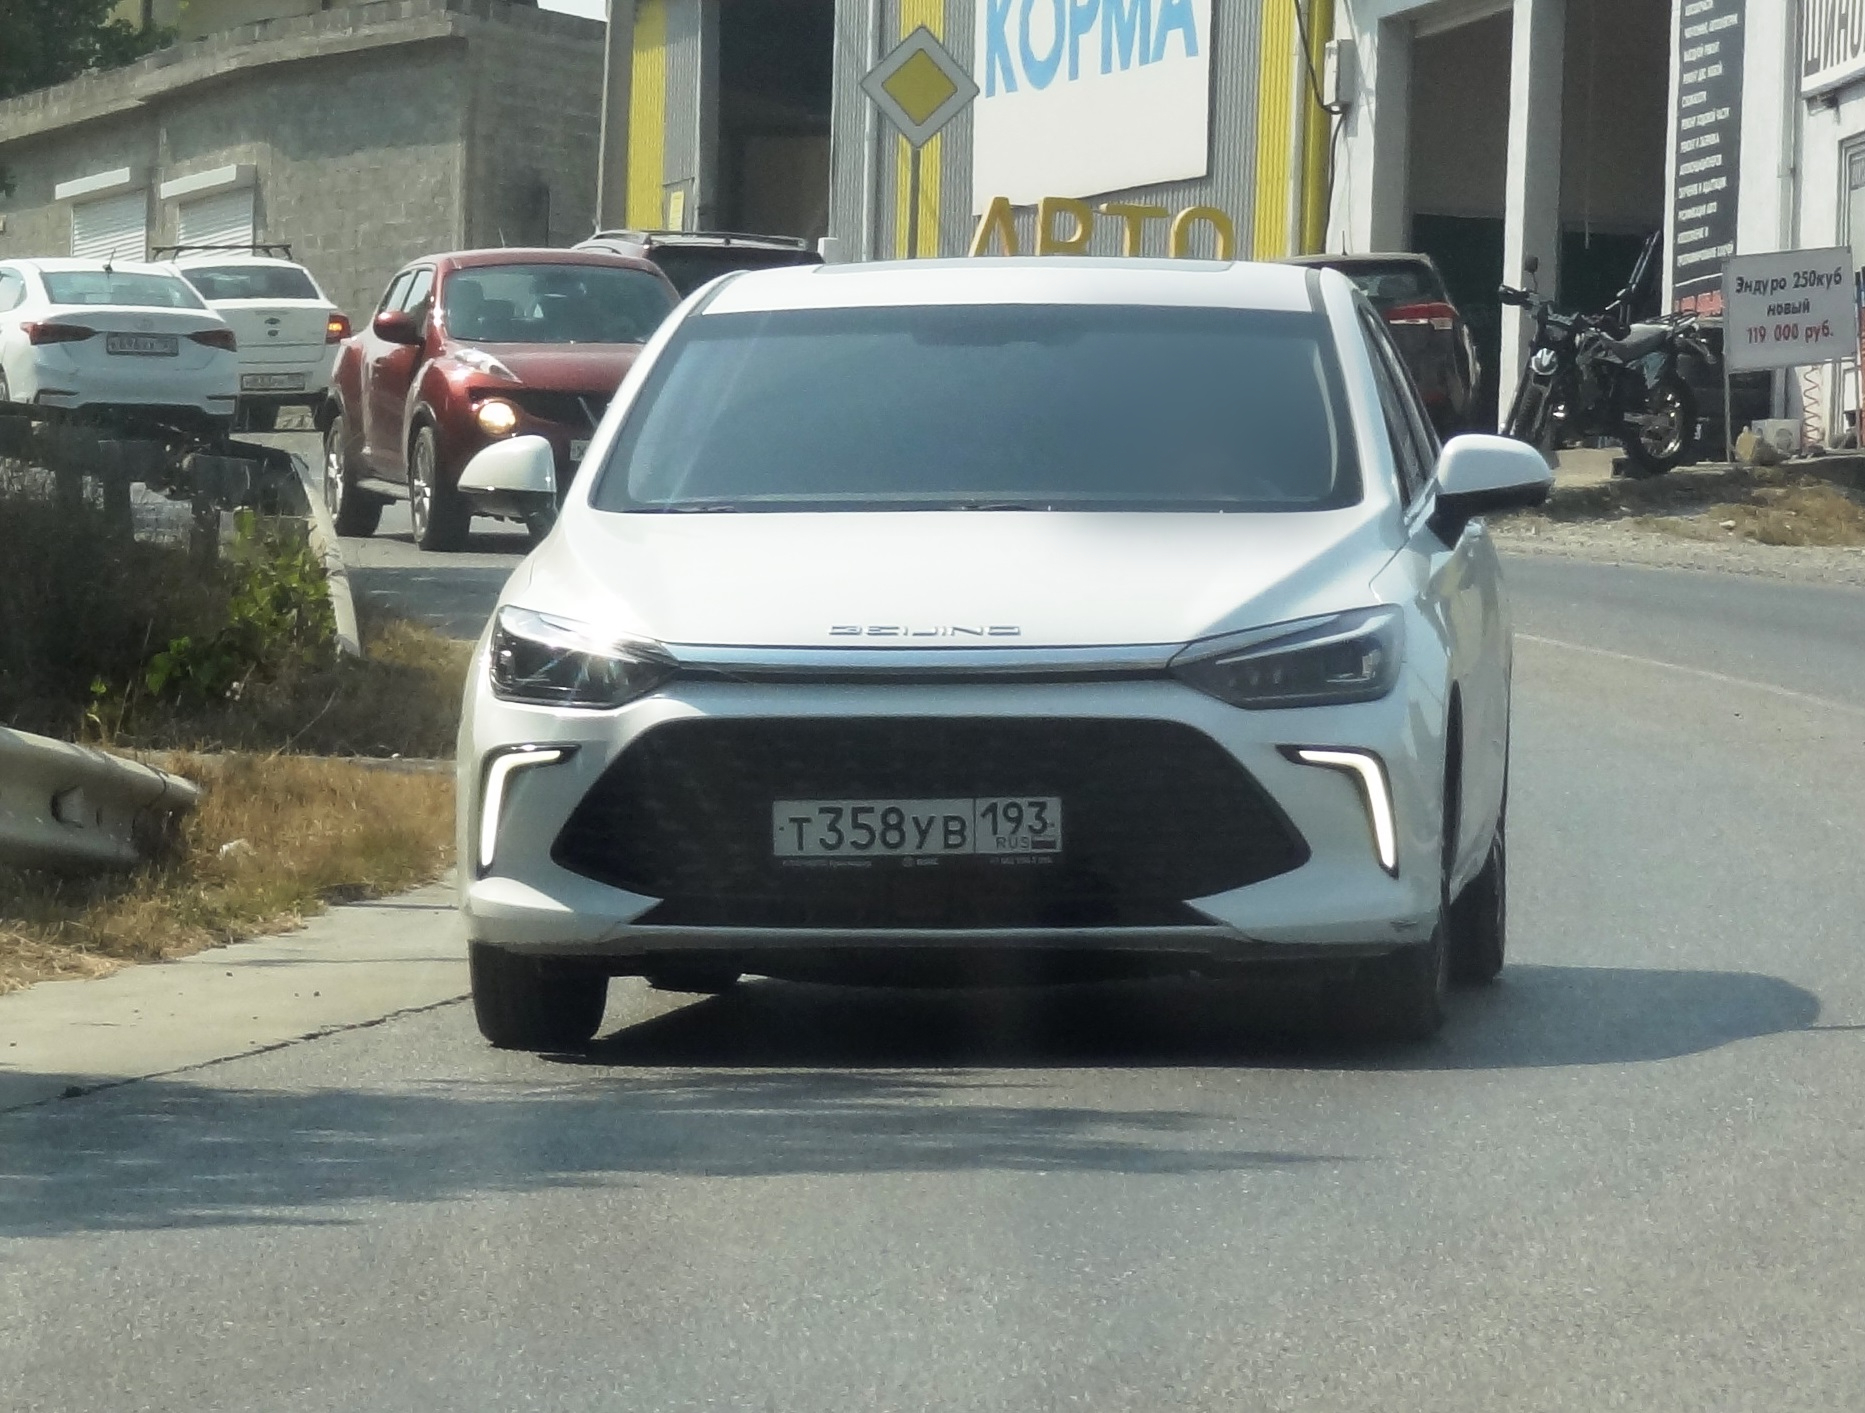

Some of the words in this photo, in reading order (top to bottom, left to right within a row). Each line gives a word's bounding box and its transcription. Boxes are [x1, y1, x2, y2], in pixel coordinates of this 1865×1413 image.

[985, 0, 1199, 98] КОРМА
[1803, 0, 1865, 77] ШИНО
[1735, 276, 1787, 296] Эндуро
[1792, 266, 1843, 290] 250куб
[1767, 298, 1811, 317] новый
[1746, 326, 1767, 344] 119
[1774, 323, 1799, 342] 000
[1805, 319, 1834, 344] руб.
[788, 806, 968, 851] Т358УВ
[980, 800, 1049, 836] 193
[996, 836, 1030, 849] RUS
